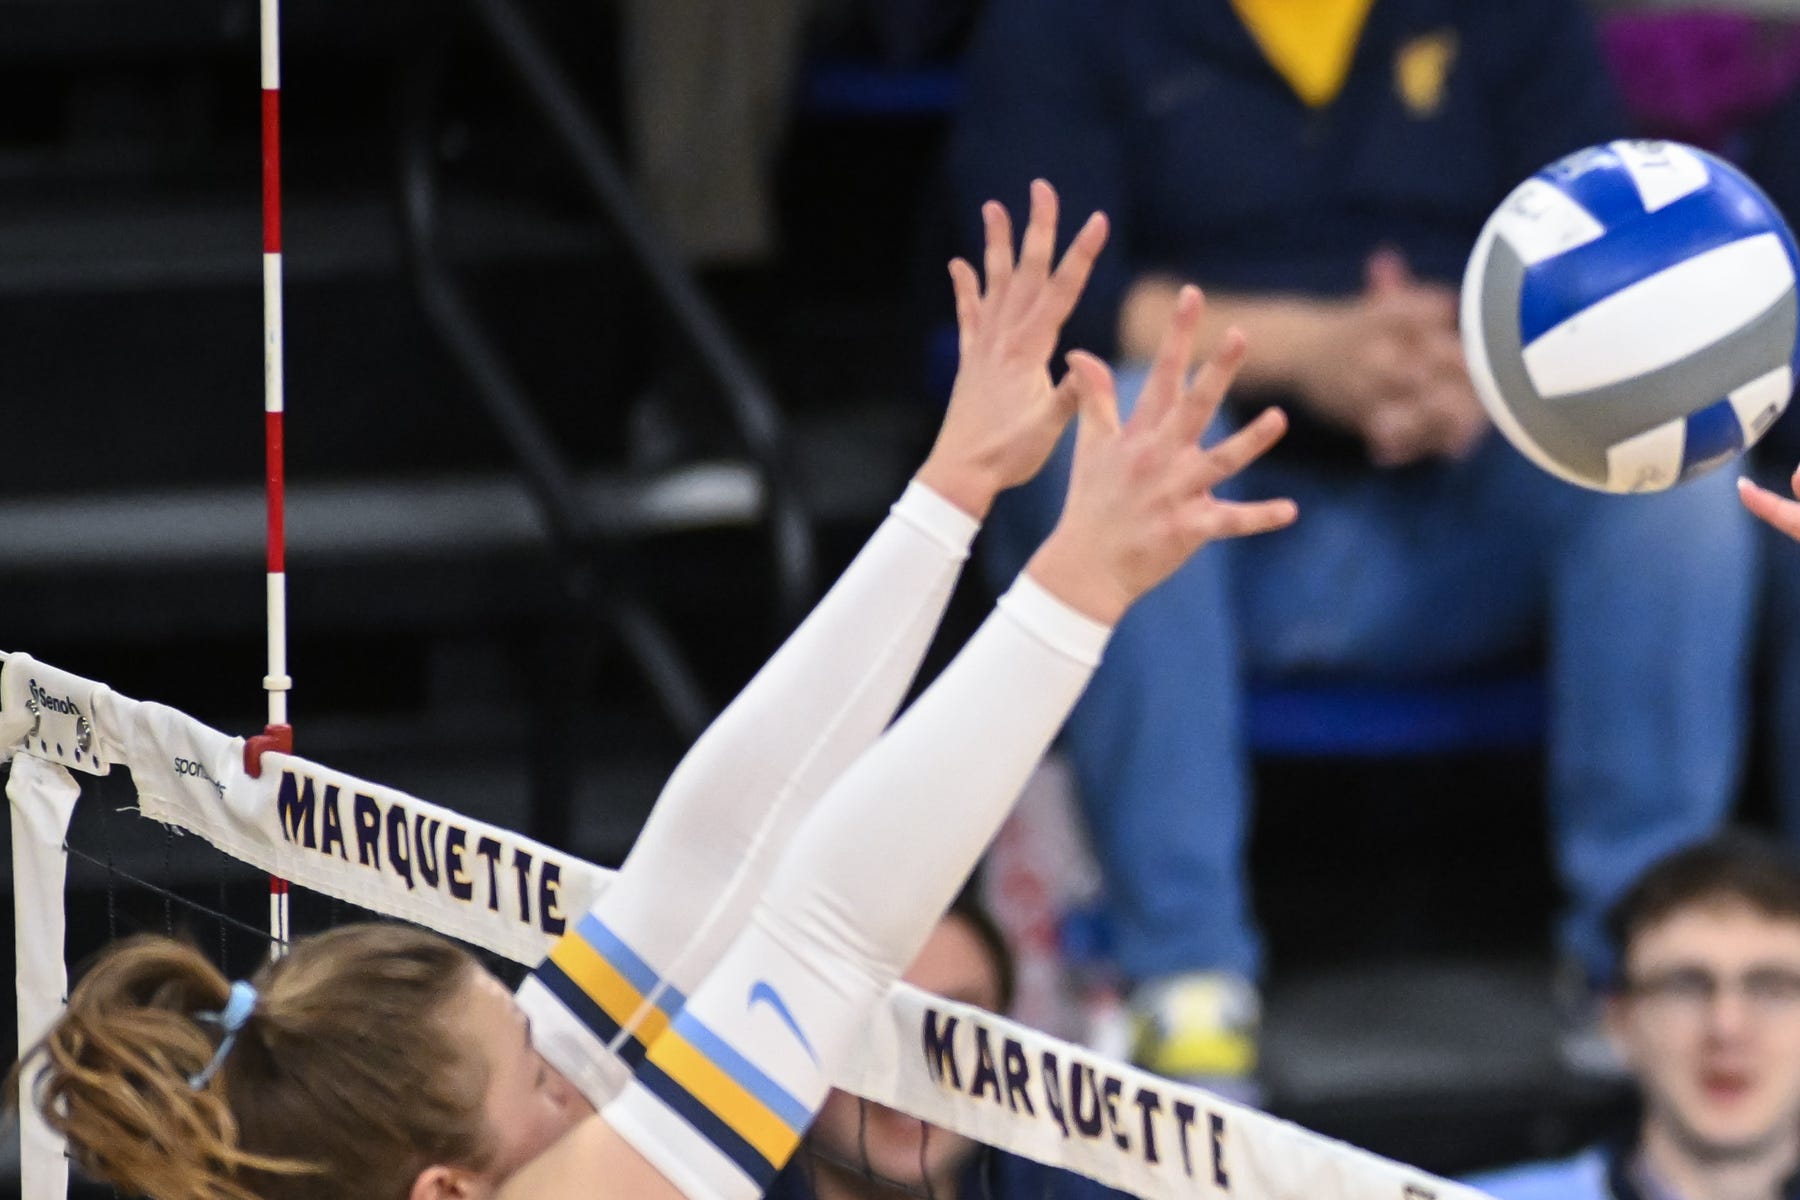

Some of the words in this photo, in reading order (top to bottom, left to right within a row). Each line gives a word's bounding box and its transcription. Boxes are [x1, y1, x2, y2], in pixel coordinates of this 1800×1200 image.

[39, 687, 81, 715] Senoh
[277, 768, 567, 936] MARQUETTE
[922, 1007, 1231, 1190] MARQUETTE
